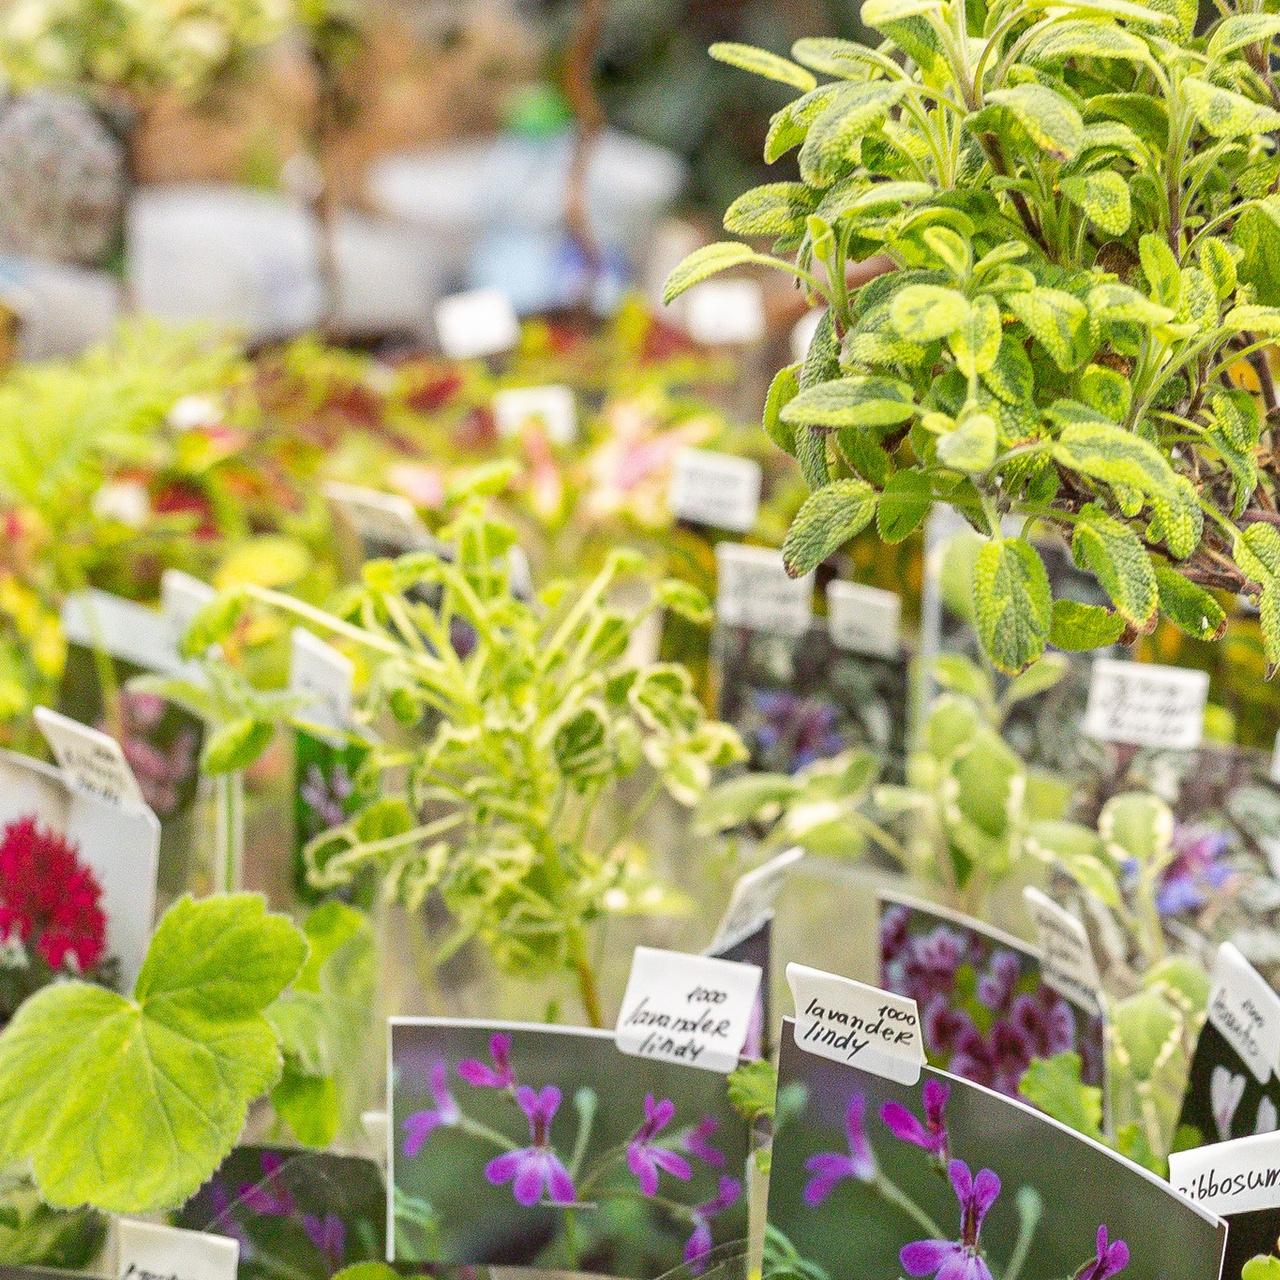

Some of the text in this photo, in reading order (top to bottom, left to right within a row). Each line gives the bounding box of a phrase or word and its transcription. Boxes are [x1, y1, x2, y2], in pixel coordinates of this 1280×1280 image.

[878, 1004, 917, 1026] 1000
[639, 1031, 705, 1061] lindy
[803, 1021, 869, 1060] lindy
